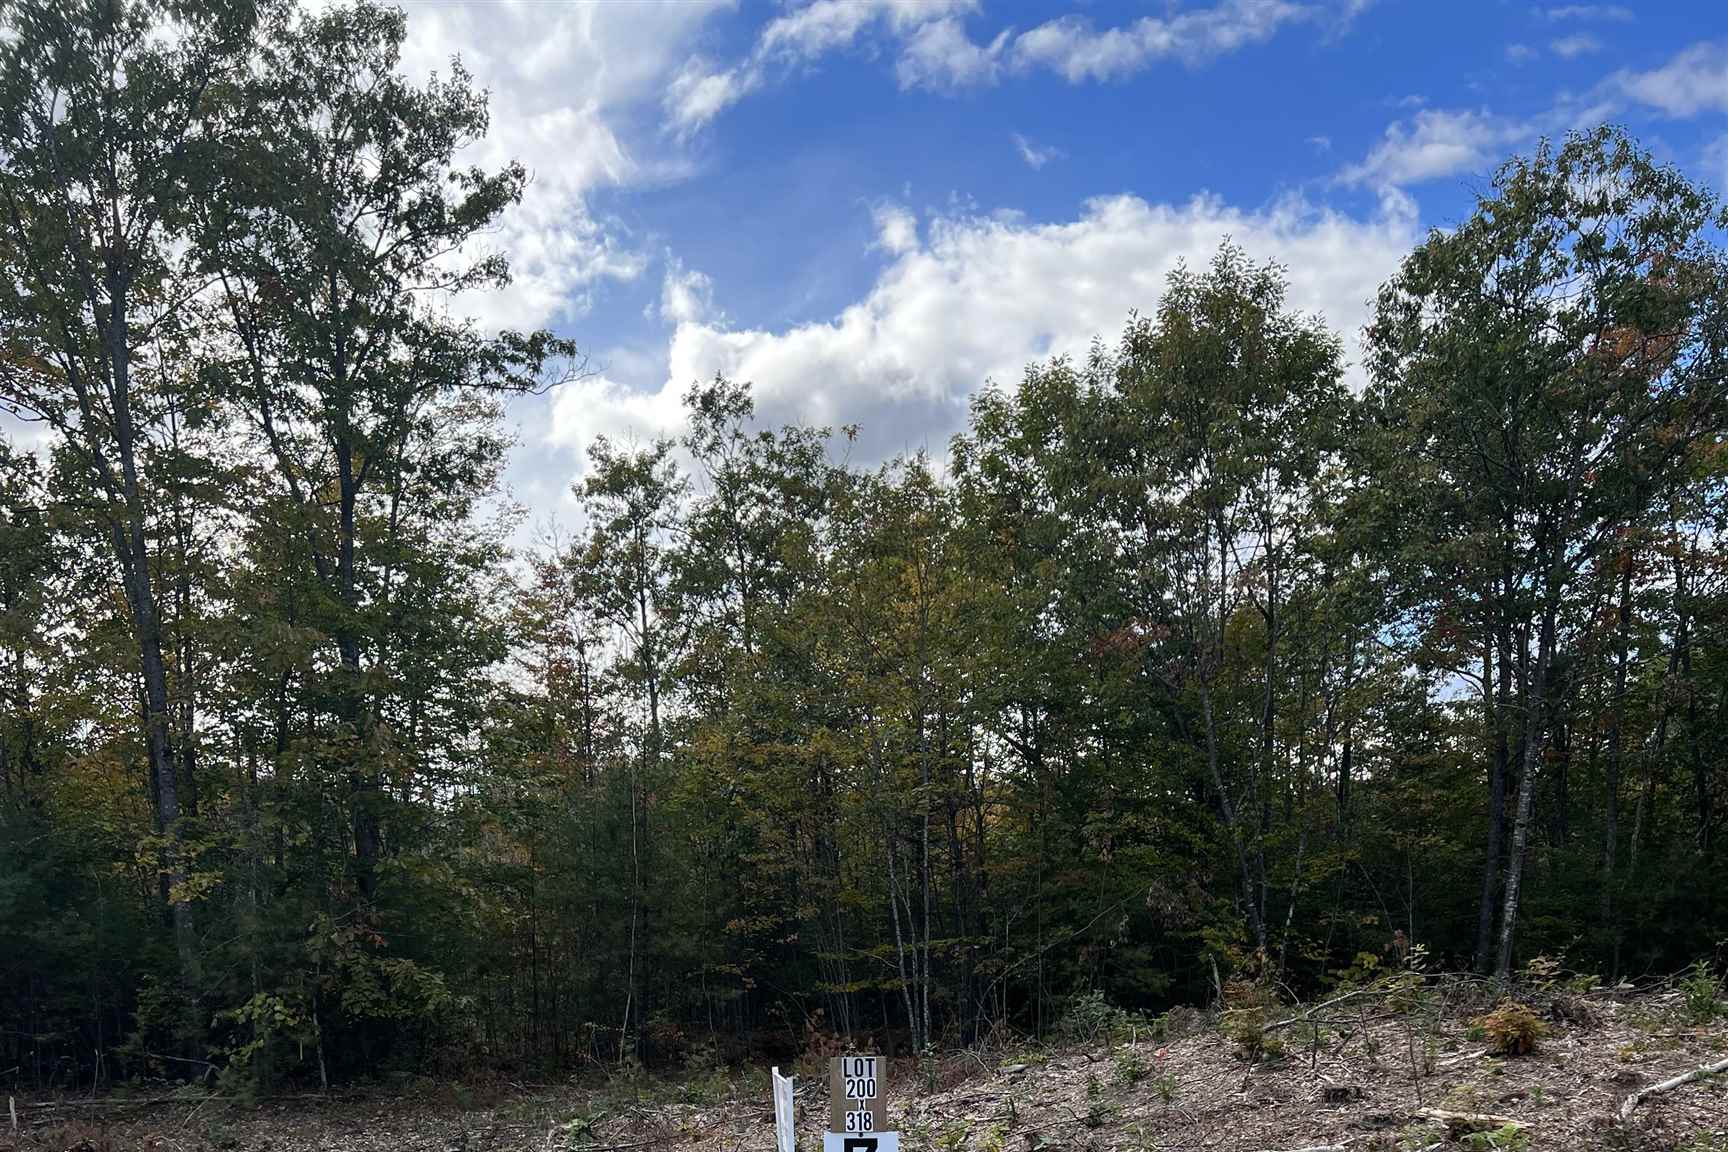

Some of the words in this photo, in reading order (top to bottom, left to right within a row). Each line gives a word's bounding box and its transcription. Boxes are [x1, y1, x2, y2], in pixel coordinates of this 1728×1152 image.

[843, 1058, 875, 1078] LOT
[846, 1079, 876, 1098] 200
[846, 1112, 873, 1131] 318
